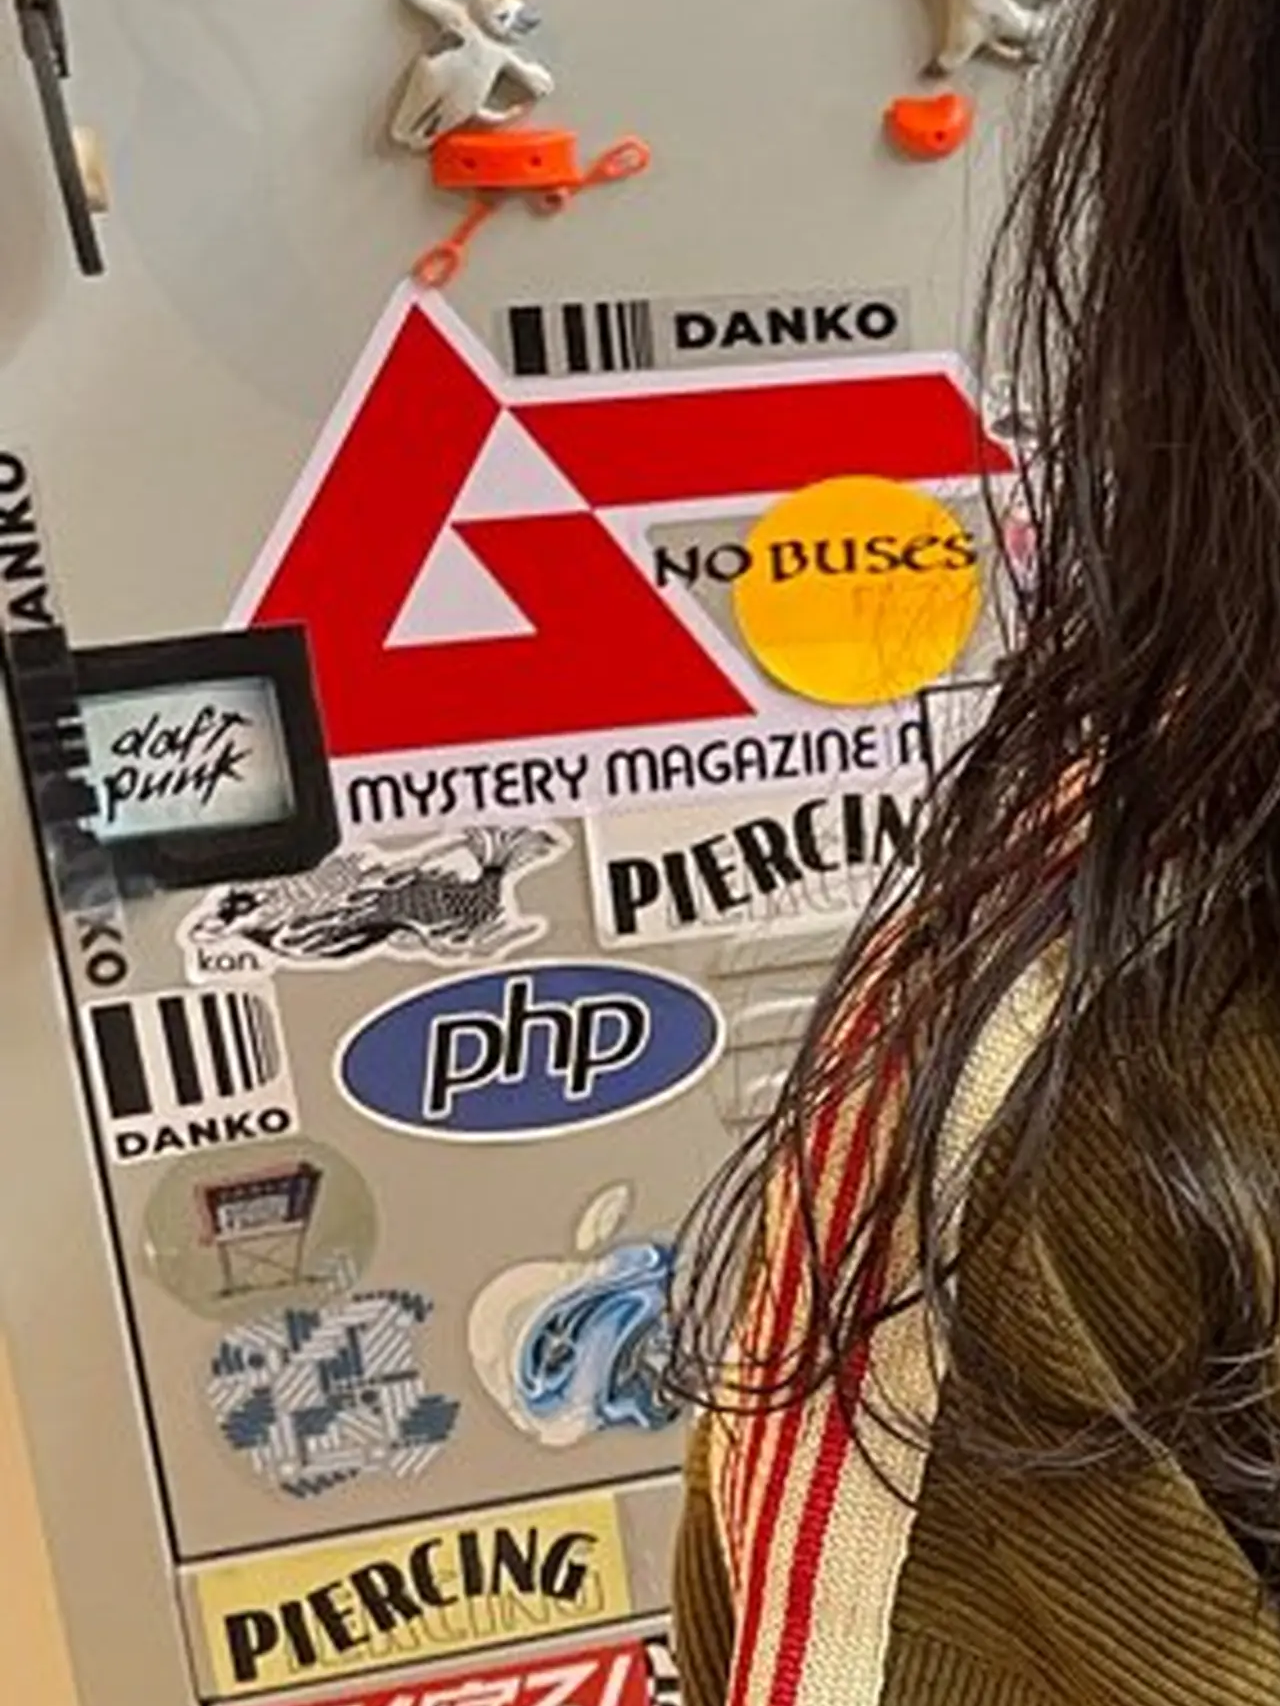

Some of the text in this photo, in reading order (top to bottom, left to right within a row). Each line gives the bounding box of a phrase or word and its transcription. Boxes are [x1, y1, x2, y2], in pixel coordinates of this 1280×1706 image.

[674, 302, 898, 350] DANKO
[0, 451, 54, 631] ANKO
[653, 544, 752, 587] NO
[110, 704, 252, 761] daft
[349, 755, 588, 824] MYSTERY
[607, 724, 877, 797] MAGAZINE
[103, 741, 252, 822] punk
[607, 794, 928, 935] PIERCIN
[427, 982, 646, 1115] php
[115, 1108, 290, 1159] DANKO
[224, 1527, 599, 1682] PIERCING
